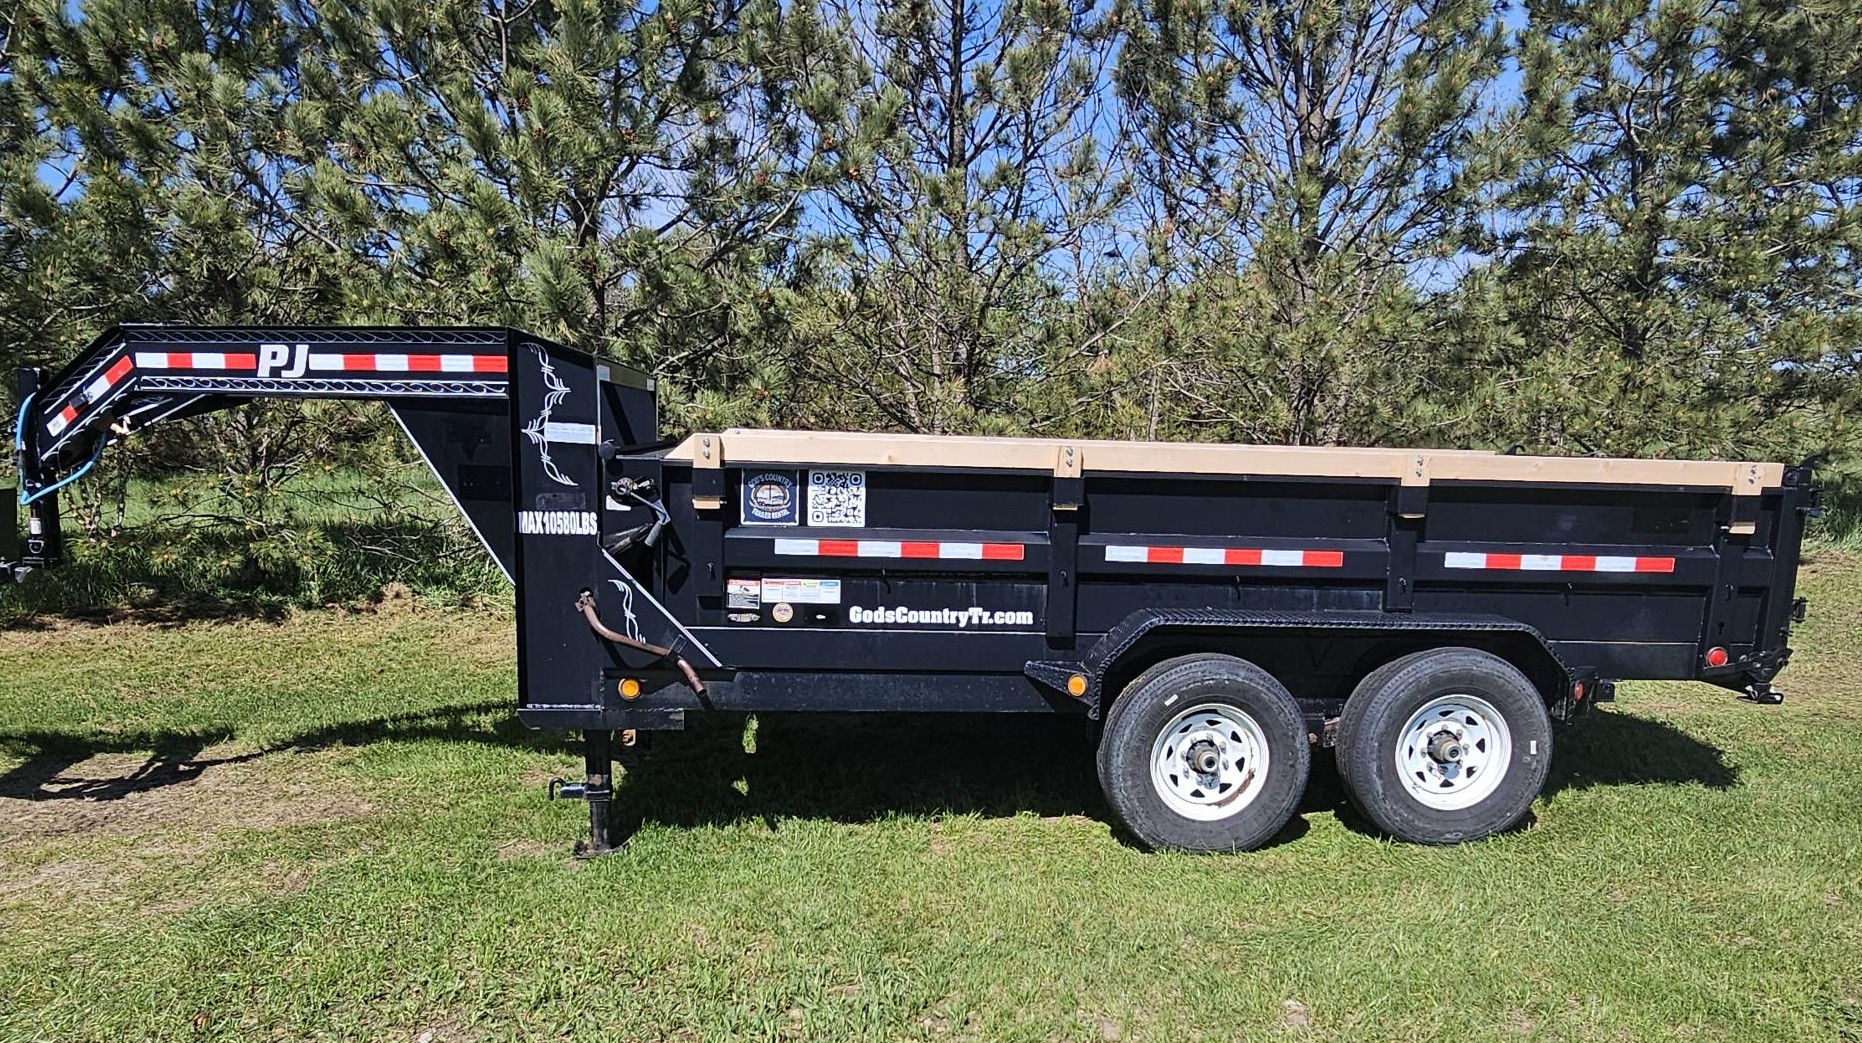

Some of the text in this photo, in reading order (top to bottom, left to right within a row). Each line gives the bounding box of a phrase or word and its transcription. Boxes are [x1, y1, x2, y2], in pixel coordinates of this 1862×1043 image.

[257, 344, 309, 378] PJ
[764, 473, 793, 488] COUNTRY
[518, 511, 598, 535] MAX10580LBS
[849, 605, 1034, 627] GodsCountryTr.com
